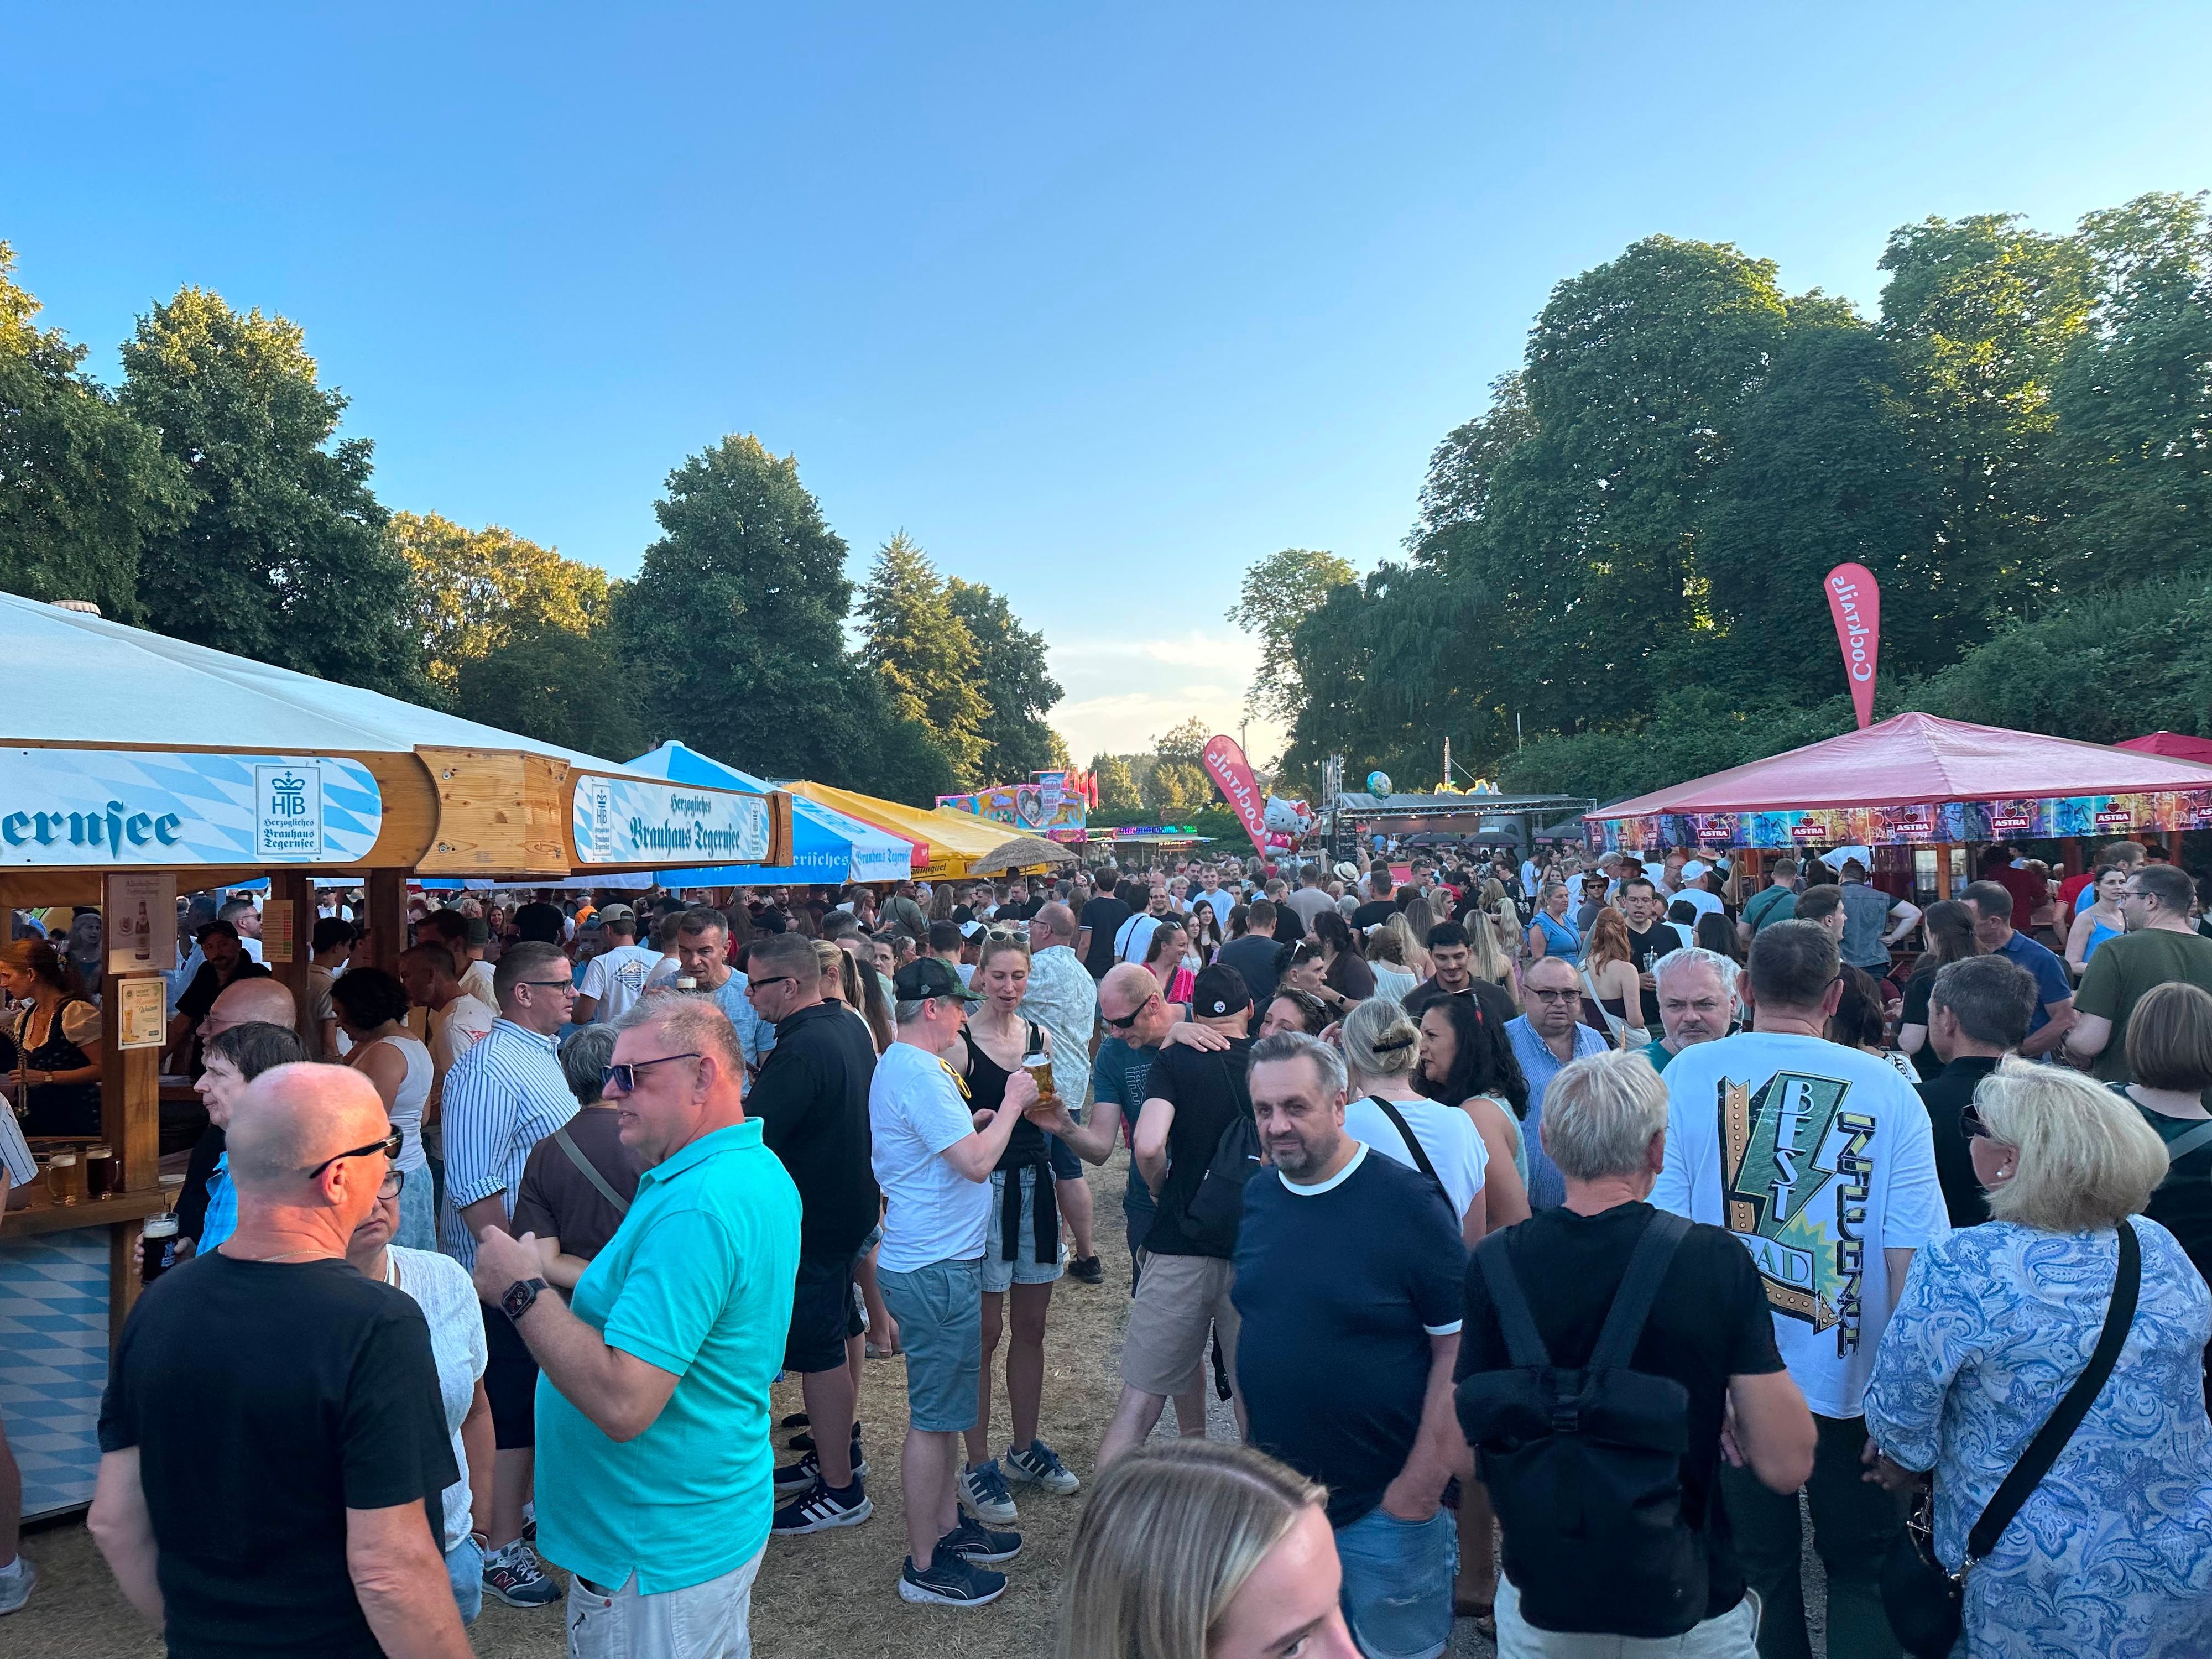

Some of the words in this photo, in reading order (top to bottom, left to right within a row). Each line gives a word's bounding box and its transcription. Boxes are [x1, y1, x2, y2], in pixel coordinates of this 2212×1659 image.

[263, 818, 314, 828] Herzogliches
[1994, 818, 2027, 827] ASTRA
[2098, 813, 2129, 822] ASTRA
[1793, 827, 1824, 836] ASTRA
[1896, 823, 1929, 831] ASTRA
[263, 828, 314, 840] Brauhaus
[630, 816, 691, 858] Brauhaus
[694, 820, 740, 858] Tegernsee
[264, 838, 315, 850] Tegernsee
[793, 851, 849, 870] erisches
[1771, 1079, 1814, 1221] BEST
